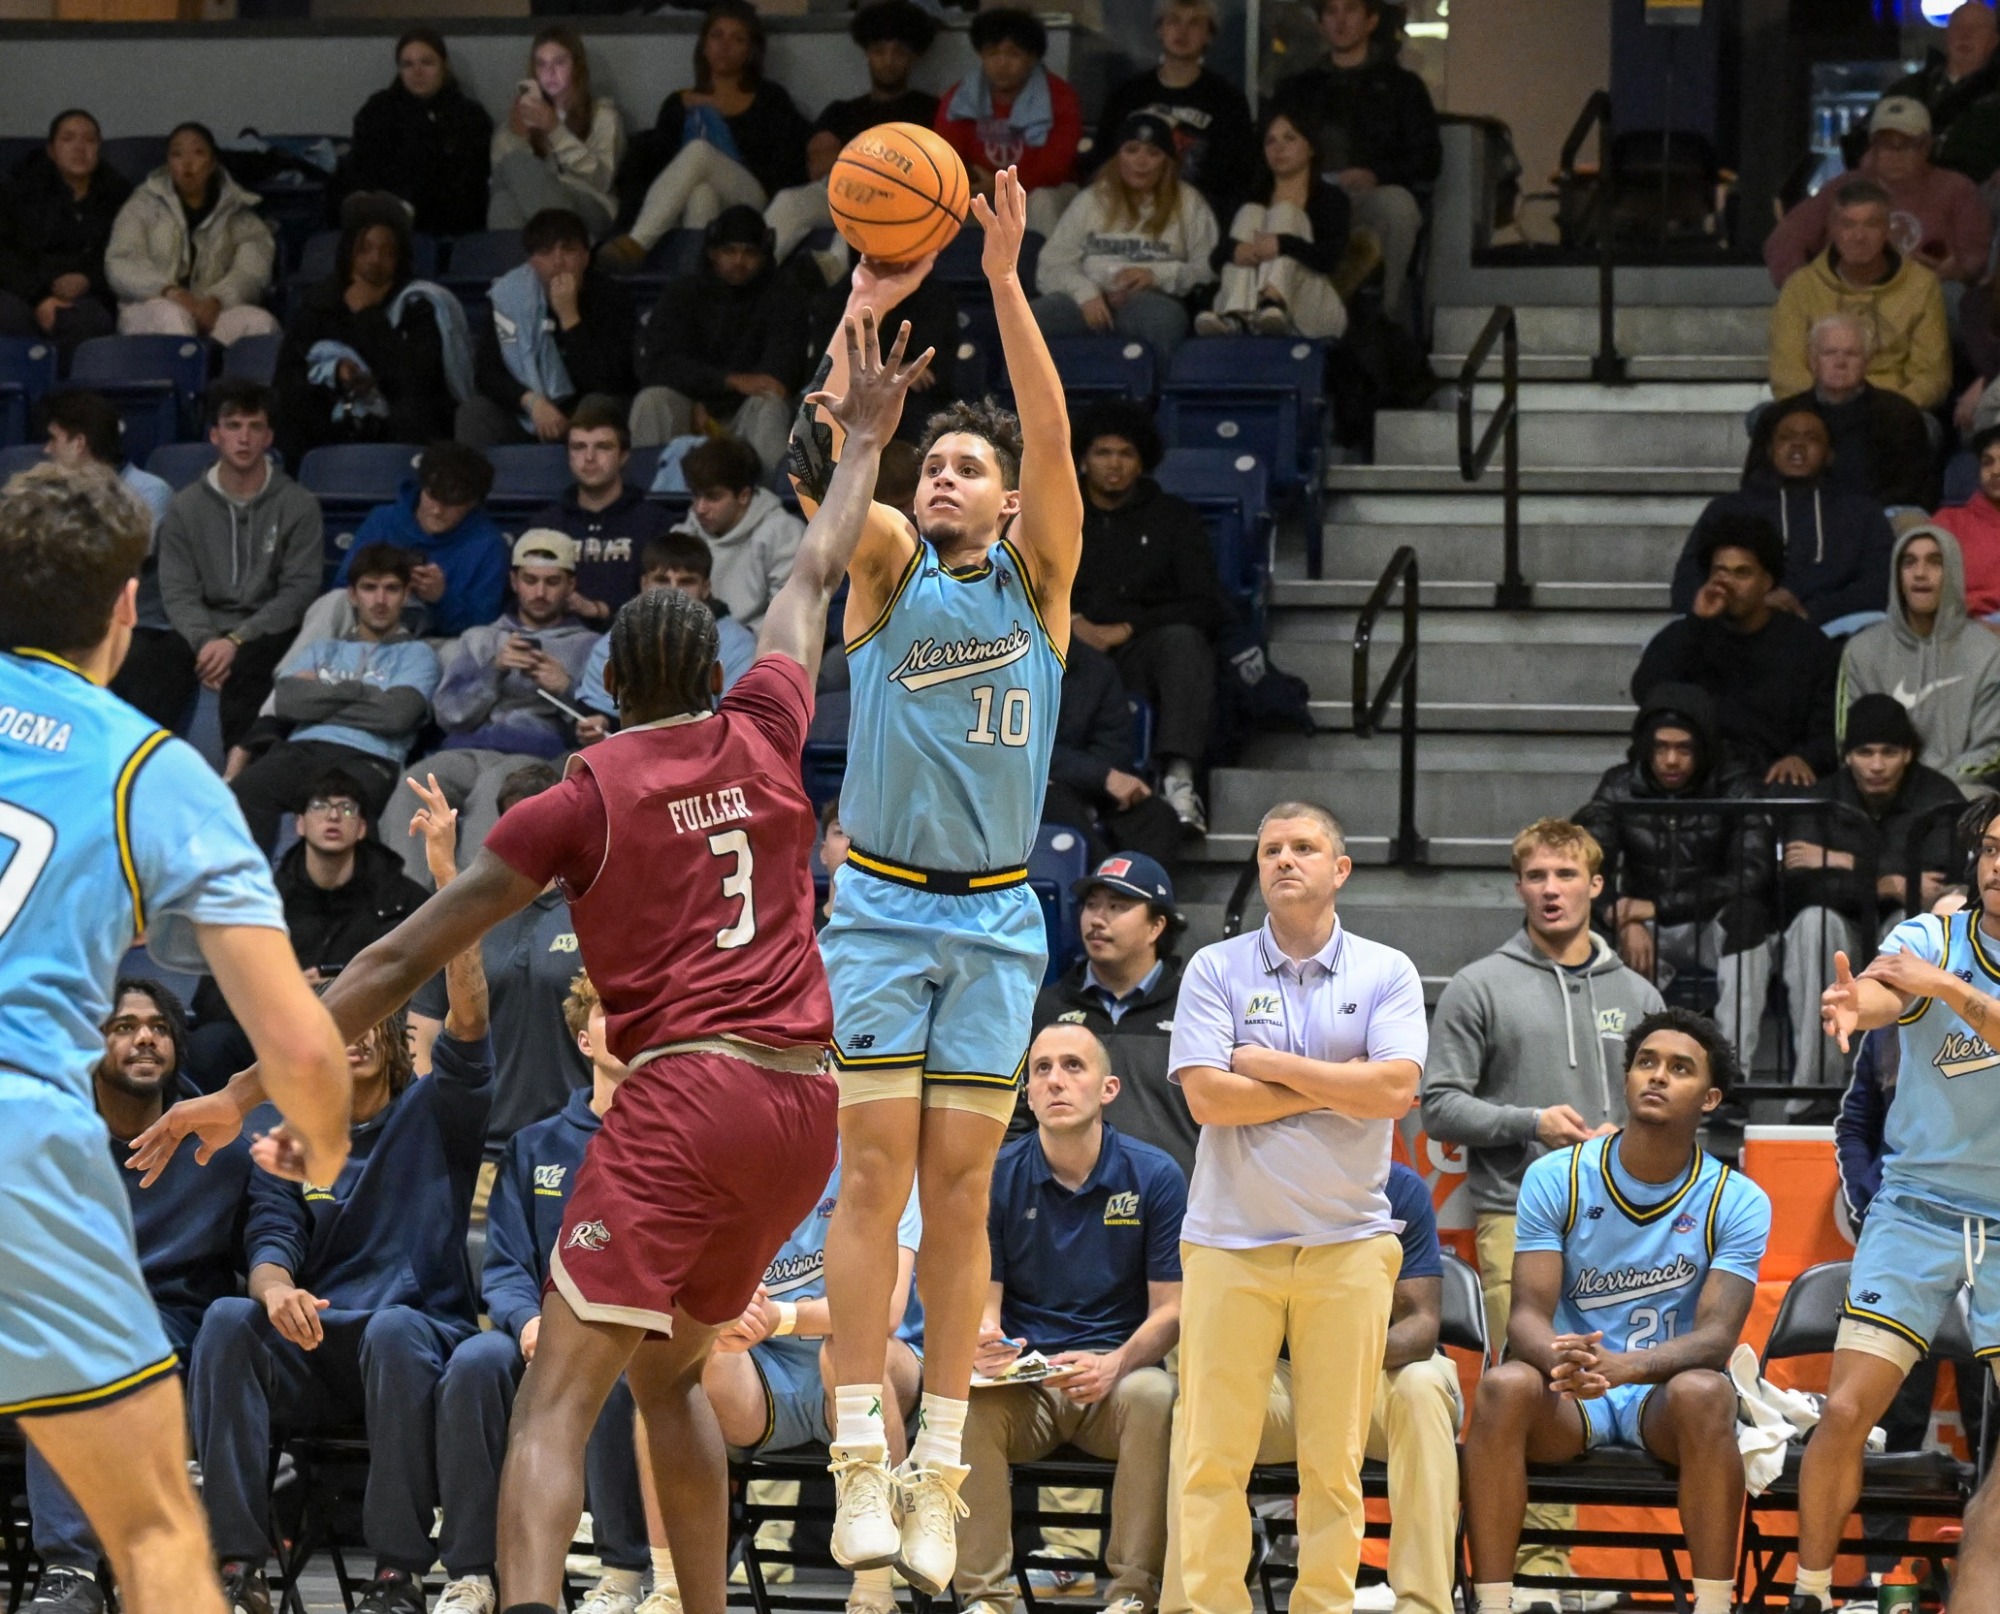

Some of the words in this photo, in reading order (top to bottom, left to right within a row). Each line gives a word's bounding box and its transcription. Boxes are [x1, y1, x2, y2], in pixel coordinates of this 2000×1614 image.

[888, 620, 1031, 683] Merrimack
[966, 685, 1031, 747] 10
[667, 786, 753, 834] FULLER
[708, 828, 756, 950] 3
[1244, 1019, 1283, 1027] BASKETBALL
[1246, 994, 1281, 1018] MC
[1104, 1190, 1140, 1219] MC
[763, 1249, 825, 1283] errimac
[1568, 1254, 1698, 1299] Merrimack
[1626, 1306, 1680, 1353] 21
